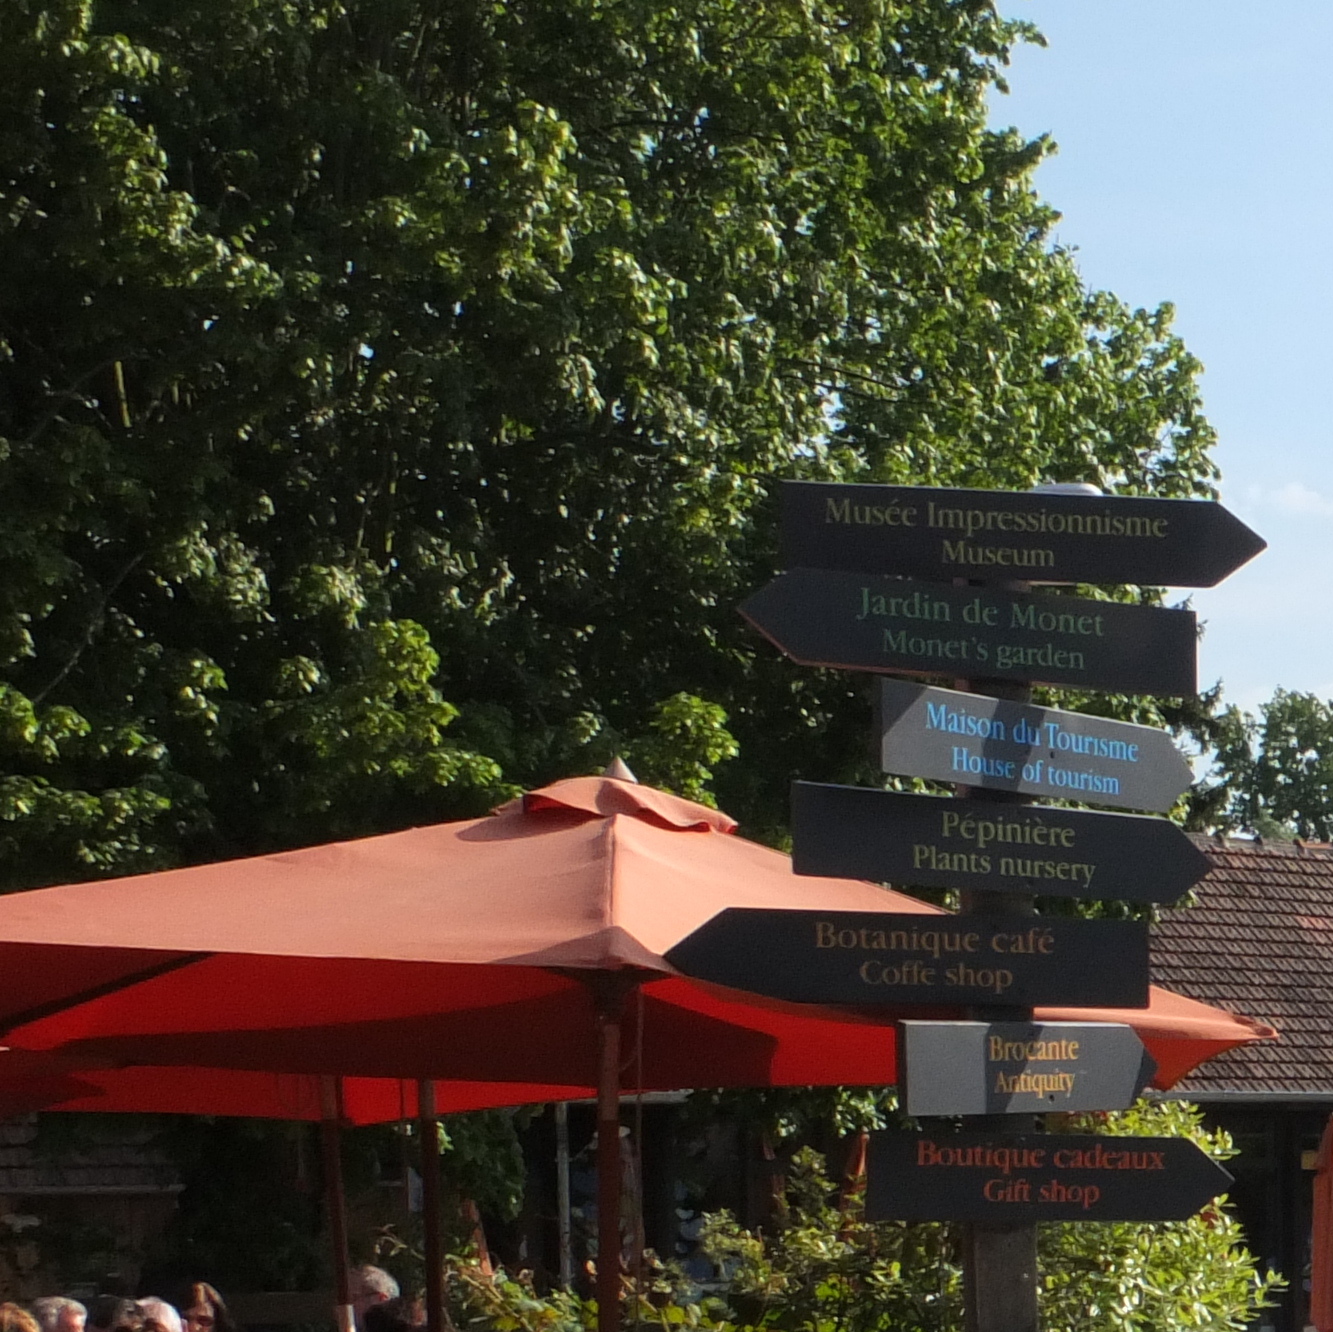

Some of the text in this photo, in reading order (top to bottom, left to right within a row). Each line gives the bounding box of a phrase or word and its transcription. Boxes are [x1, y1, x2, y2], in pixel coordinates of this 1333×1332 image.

[826, 498, 1169, 539] Musée Impressionnisme
[942, 540, 1055, 568] Museum
[856, 586, 1104, 638] Jardin de Monet
[882, 629, 1085, 670] Monet's garden
[926, 702, 1139, 763] Maison du Tourisme
[951, 746, 1120, 796] House of tourism
[942, 810, 1076, 849] Pépinière
[913, 844, 1096, 889] Plants nursery
[815, 922, 1055, 958] Botanique café
[859, 960, 1014, 995] Coffe shop
[988, 1036, 1080, 1063] Brocante
[994, 1068, 1076, 1098] Antiquity
[916, 1141, 1166, 1174] Boutique cadeaux
[984, 1179, 1100, 1210] Gift shop
